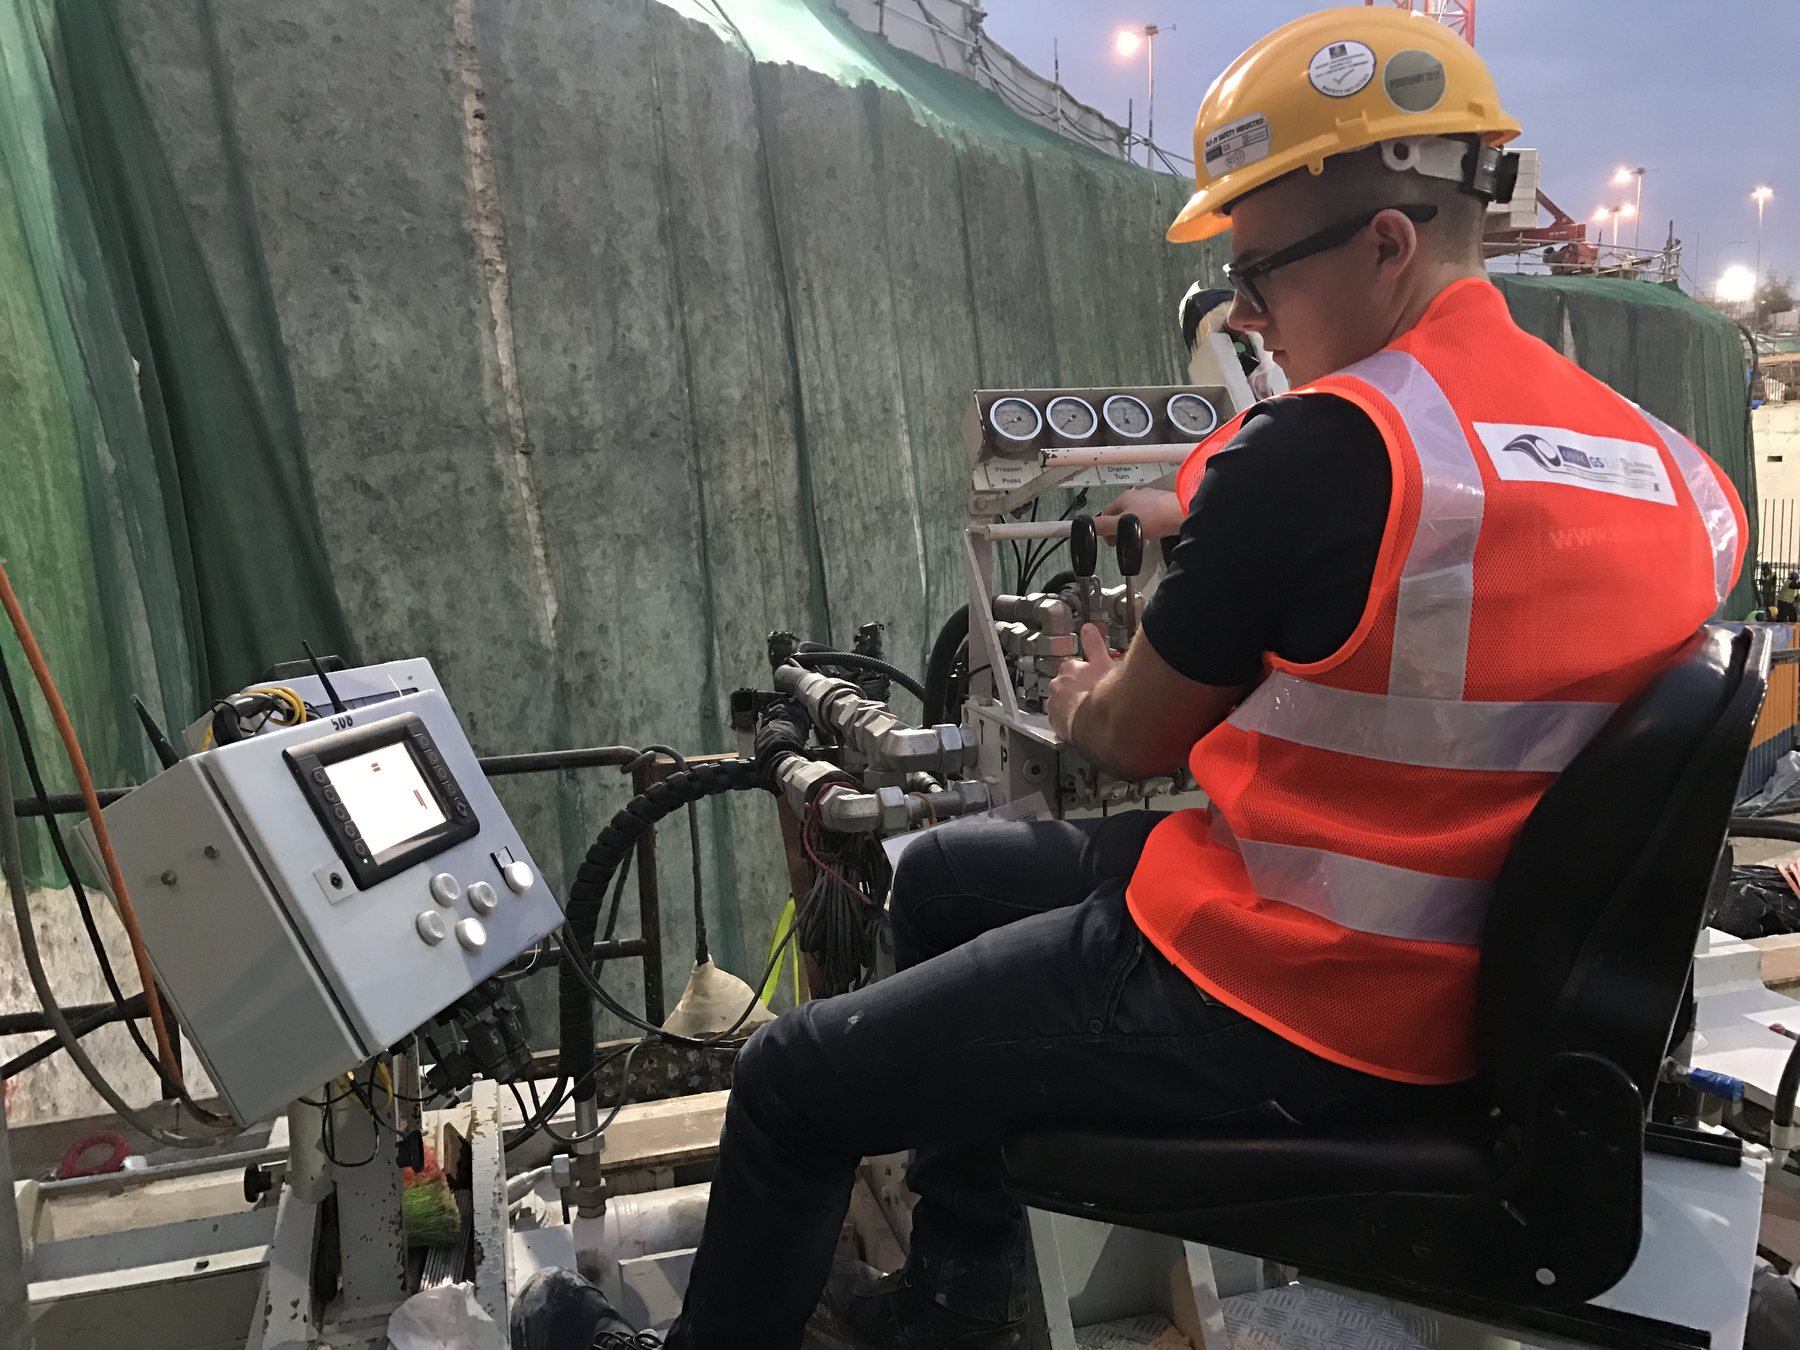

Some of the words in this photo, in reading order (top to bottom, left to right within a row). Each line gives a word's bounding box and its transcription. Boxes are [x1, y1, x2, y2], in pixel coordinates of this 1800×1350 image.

[1218, 128, 1235, 141] SAFETY
[1236, 118, 1264, 133] INDUCTED
[1589, 456, 1605, 469] GS
[330, 715, 354, 731] 508
[1000, 745, 1008, 772] P
